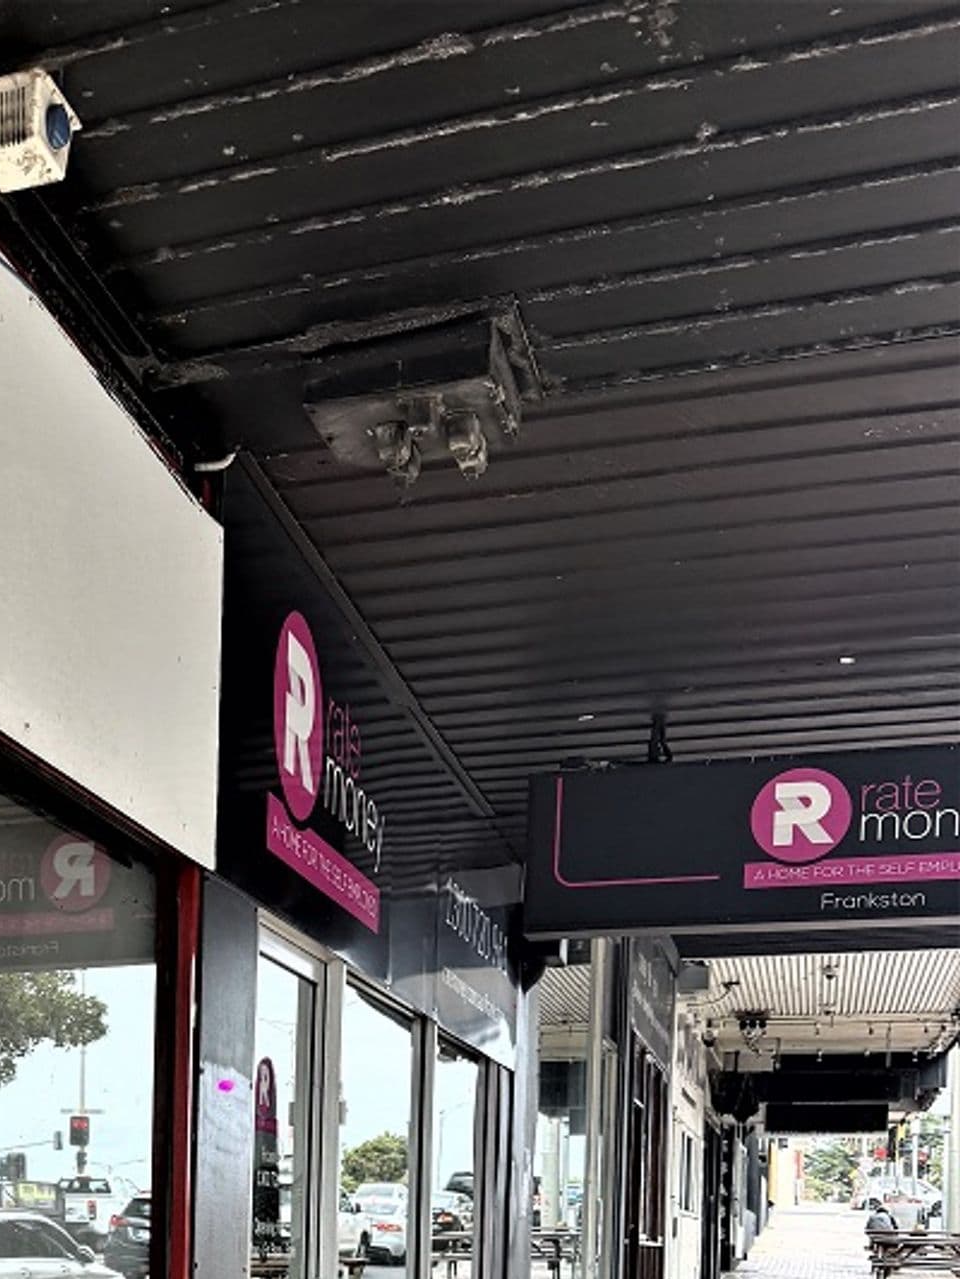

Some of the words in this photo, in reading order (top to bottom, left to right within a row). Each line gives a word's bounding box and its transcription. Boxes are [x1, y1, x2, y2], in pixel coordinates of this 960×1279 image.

[326, 697, 361, 780] rate
[860, 775, 942, 812] rate
[324, 755, 385, 874] money
[753, 869, 765, 881] A
[767, 867, 809, 881] HOME
[813, 865, 844, 879] FOR
[848, 863, 876, 877] THE
[879, 861, 915, 876] SELF
[820, 892, 926, 911] Frankston
